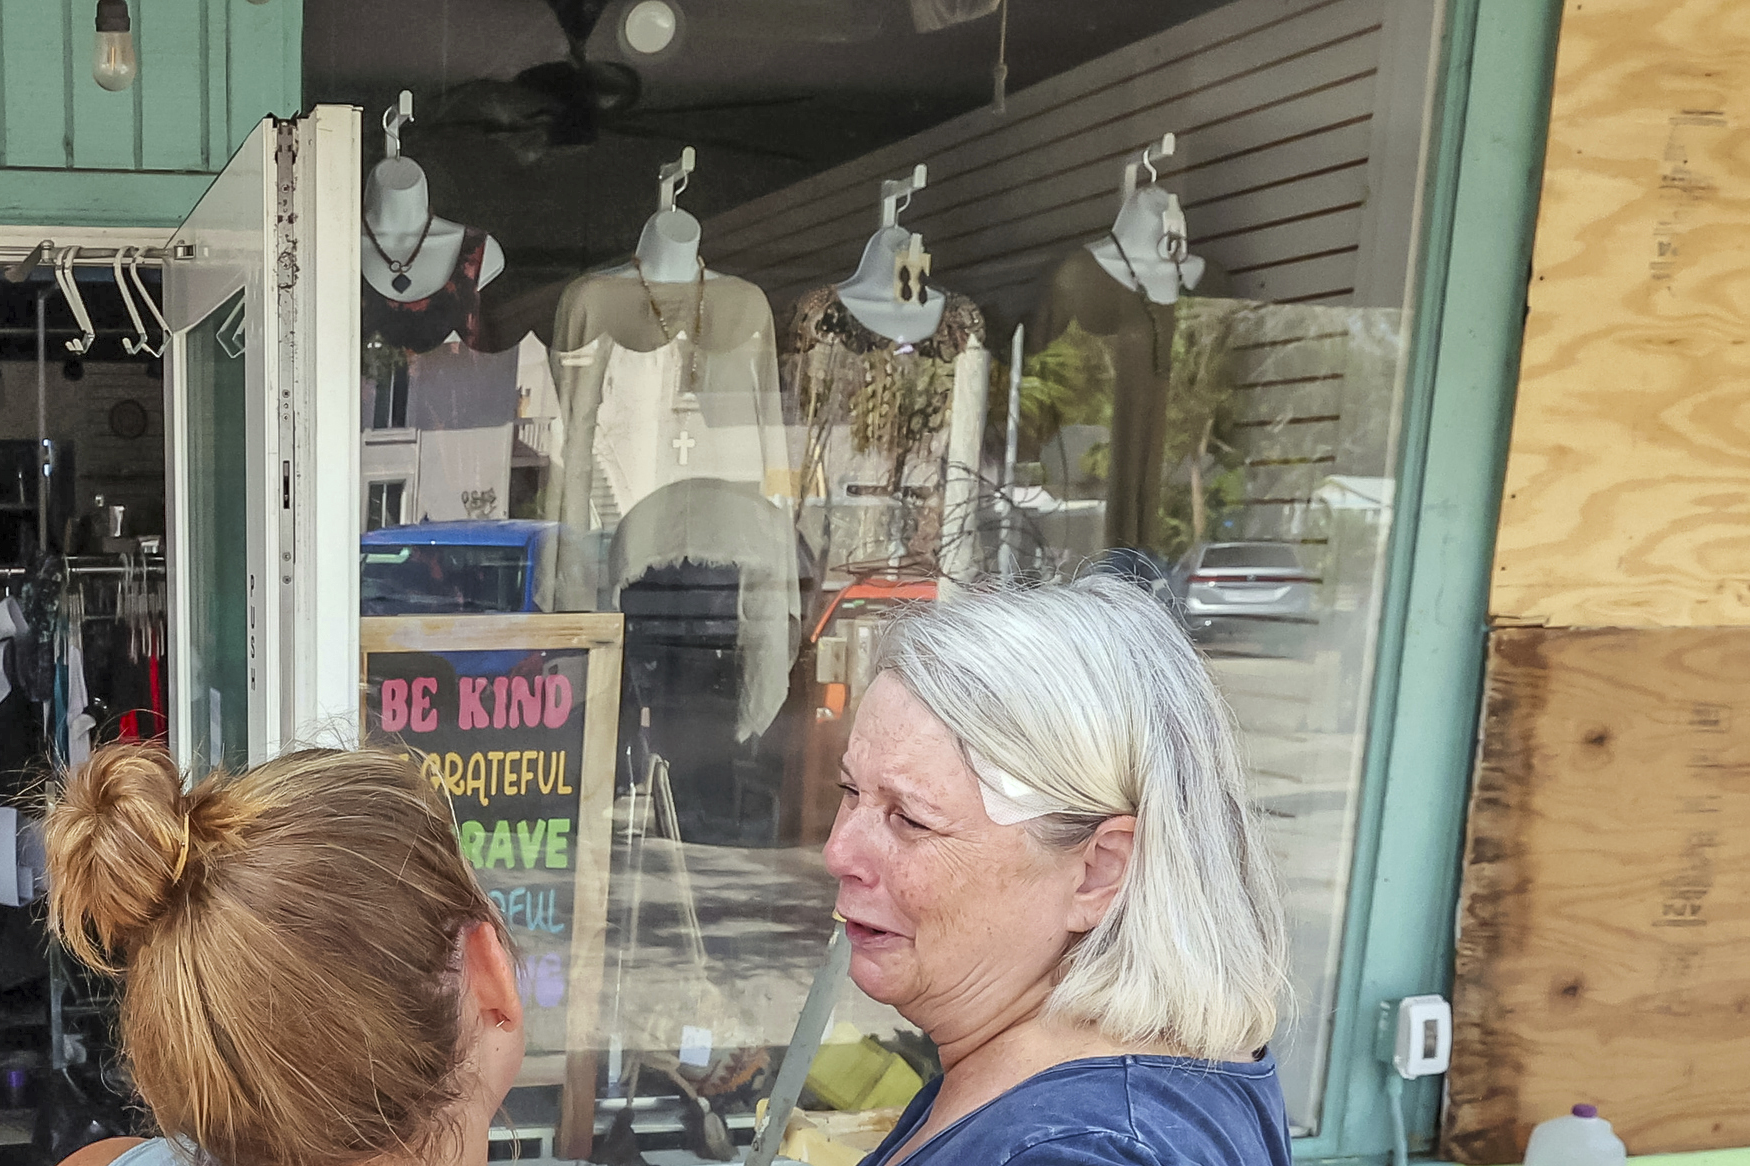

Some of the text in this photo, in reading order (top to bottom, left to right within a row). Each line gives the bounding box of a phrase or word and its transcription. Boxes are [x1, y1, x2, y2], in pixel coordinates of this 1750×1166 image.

[381, 674, 573, 732] BE KIND
[420, 750, 573, 806] GRATEFUL
[452, 818, 571, 869] RAVE
